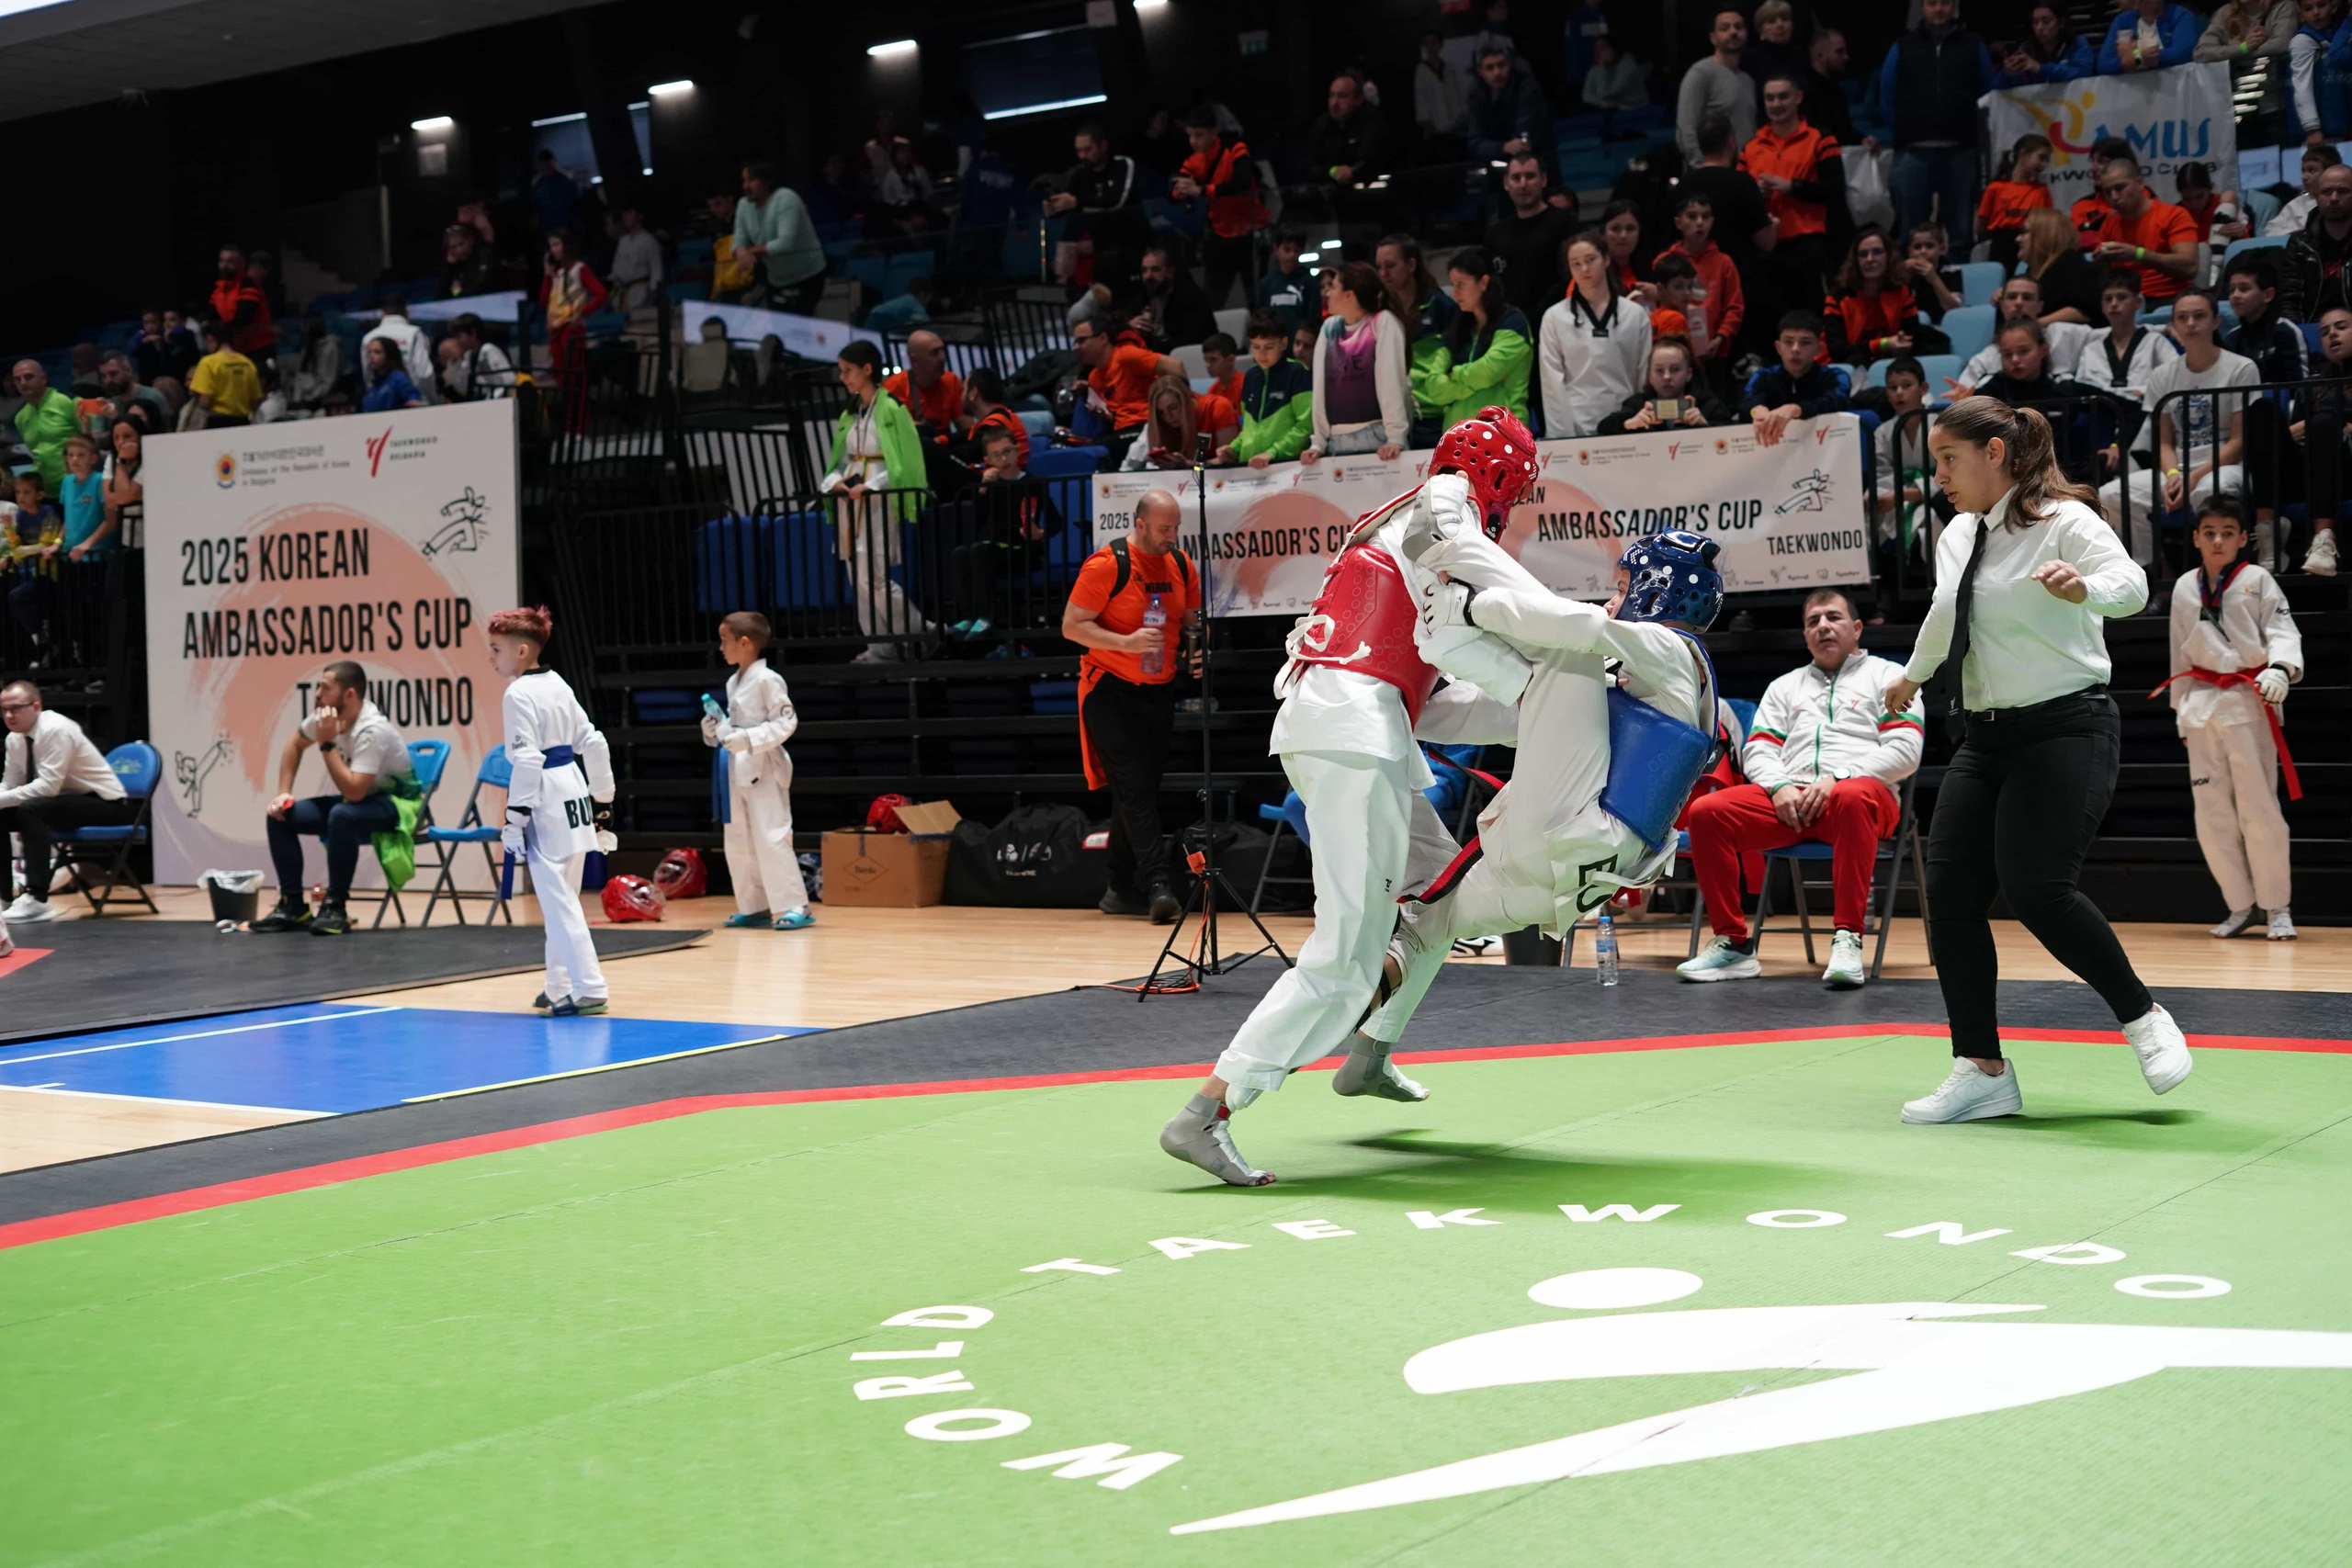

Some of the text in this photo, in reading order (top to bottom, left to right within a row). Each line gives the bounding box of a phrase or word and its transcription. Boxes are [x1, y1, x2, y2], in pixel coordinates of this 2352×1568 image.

[1100, 513, 1129, 530] 2025
[1538, 500, 1762, 542] AMBASSADOR'S CUP
[1767, 529, 1863, 555] TAEKWONDO
[182, 527, 369, 585] 2025 KOREAN
[184, 597, 472, 659] AMBASSADOR'S CUP
[297, 677, 473, 727] TWONDO
[1019, 1204, 2233, 1299] TAEKWONDO
[849, 1304, 1183, 1491] WORLD
